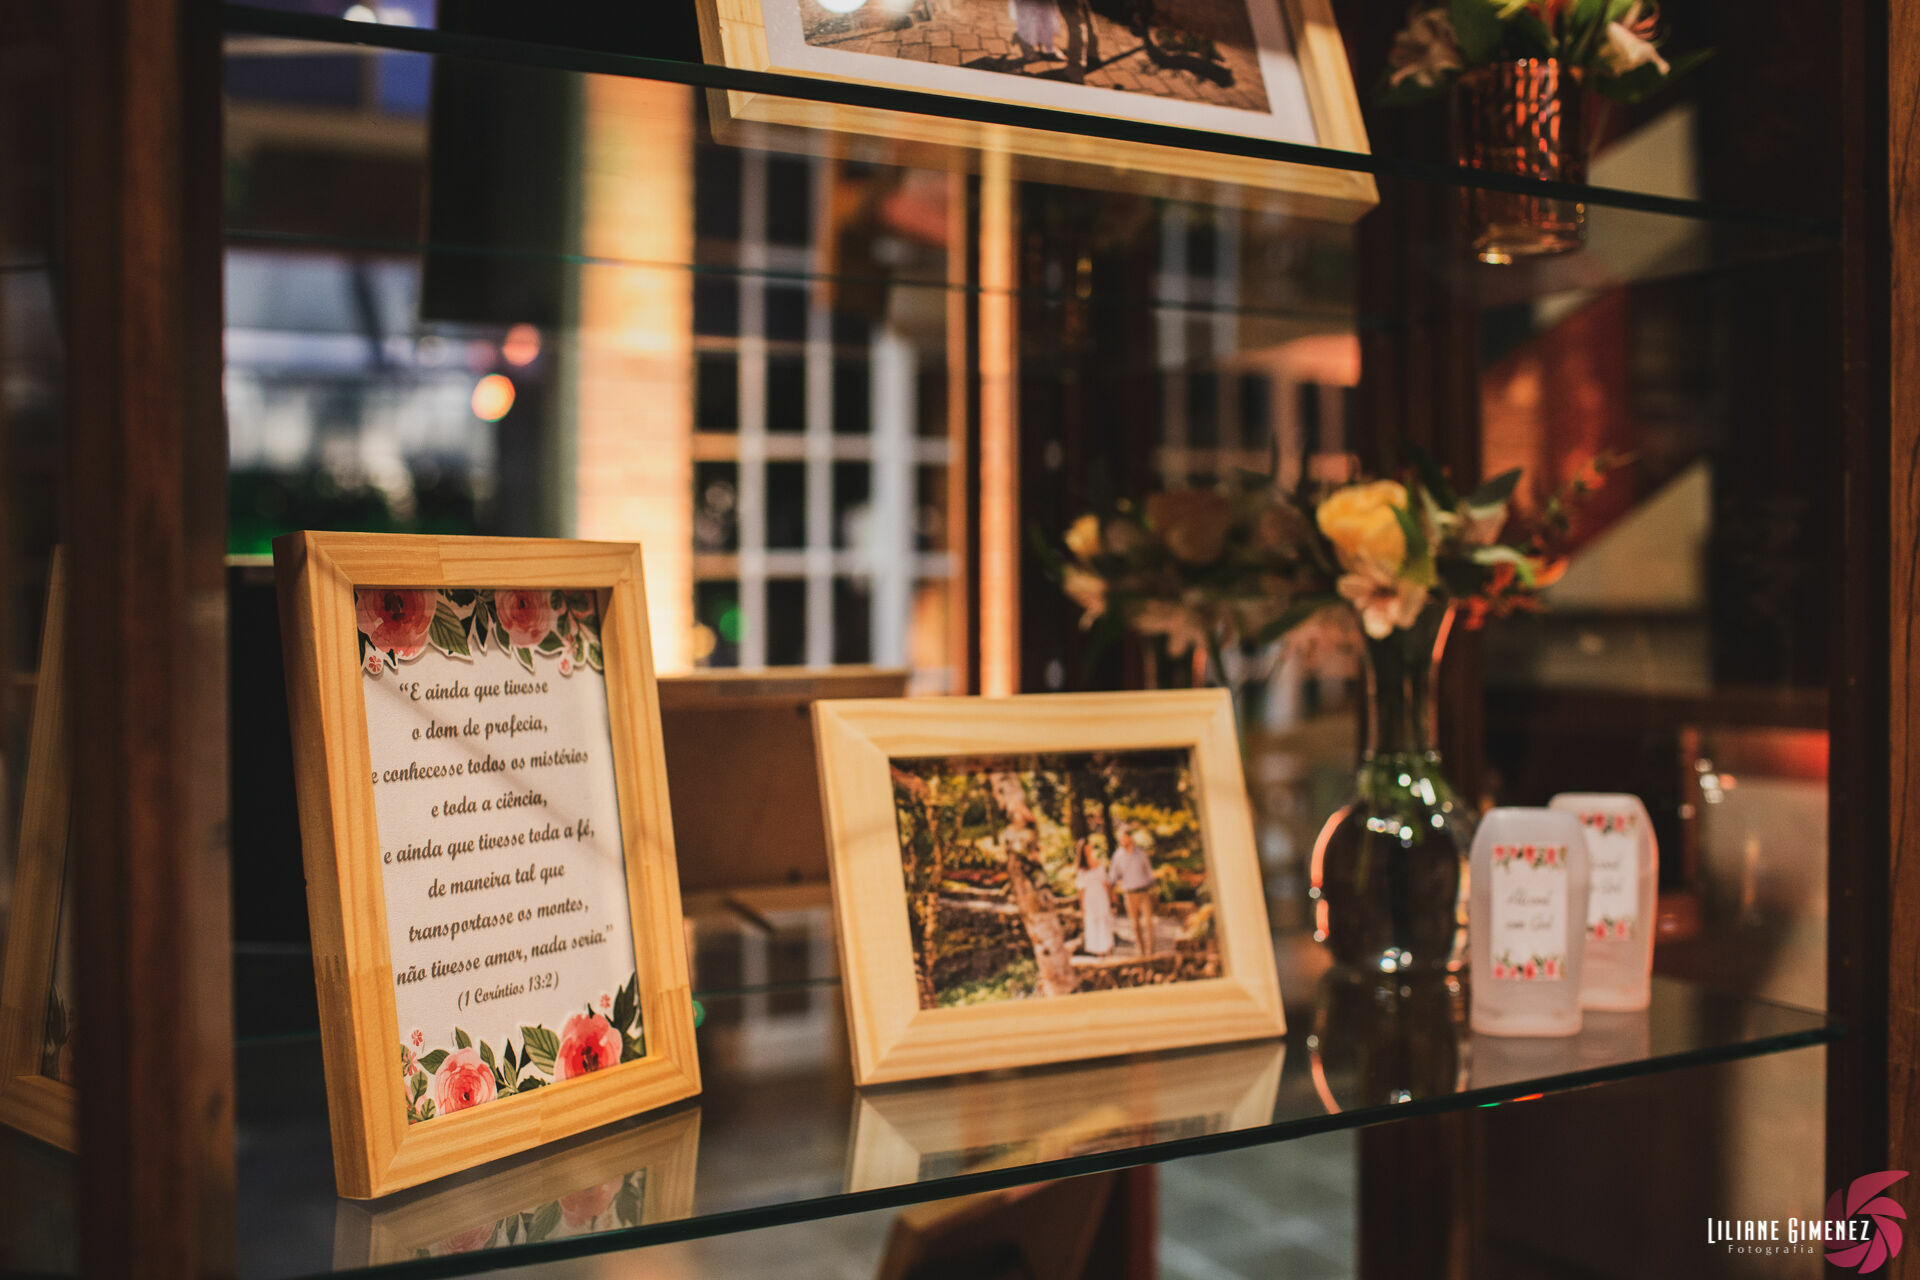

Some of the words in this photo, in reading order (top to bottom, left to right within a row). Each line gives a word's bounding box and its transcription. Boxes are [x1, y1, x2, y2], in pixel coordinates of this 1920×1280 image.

[425, 680, 469, 701] ainda
[474, 684, 500, 703] que
[504, 679, 548, 695] tivesse
[412, 727, 421, 740] o
[426, 721, 458, 739] dom
[463, 718, 481, 736] de
[485, 714, 548, 739] profecia,
[383, 761, 463, 783] conhecesse
[468, 755, 506, 774] todos
[511, 757, 525, 769] os
[530, 748, 589, 768] mistérios
[431, 804, 439, 817] e
[444, 796, 477, 816] toda
[482, 800, 491, 811] a
[496, 790, 547, 809] ciência,
[384, 851, 392, 864] e
[396, 839, 442, 863] ainda
[447, 840, 475, 861] que
[478, 831, 525, 851] tivesse
[529, 823, 560, 843] toda
[564, 827, 573, 838] a
[577, 819, 595, 842] fé,
[428, 879, 446, 898] de
[450, 871, 511, 895] maneira
[515, 864, 535, 883] tal
[540, 864, 565, 885] que
[409, 912, 514, 942] transportasse
[517, 907, 532, 921] os
[537, 899, 589, 918] montes,
[396, 966, 426, 985] não
[431, 956, 481, 979] tivesse
[485, 947, 528, 967] amor,
[531, 934, 566, 956] nada
[457, 991, 470, 1011] (1
[474, 983, 524, 1005] Coríntios
[528, 971, 559, 992] 13:2)
